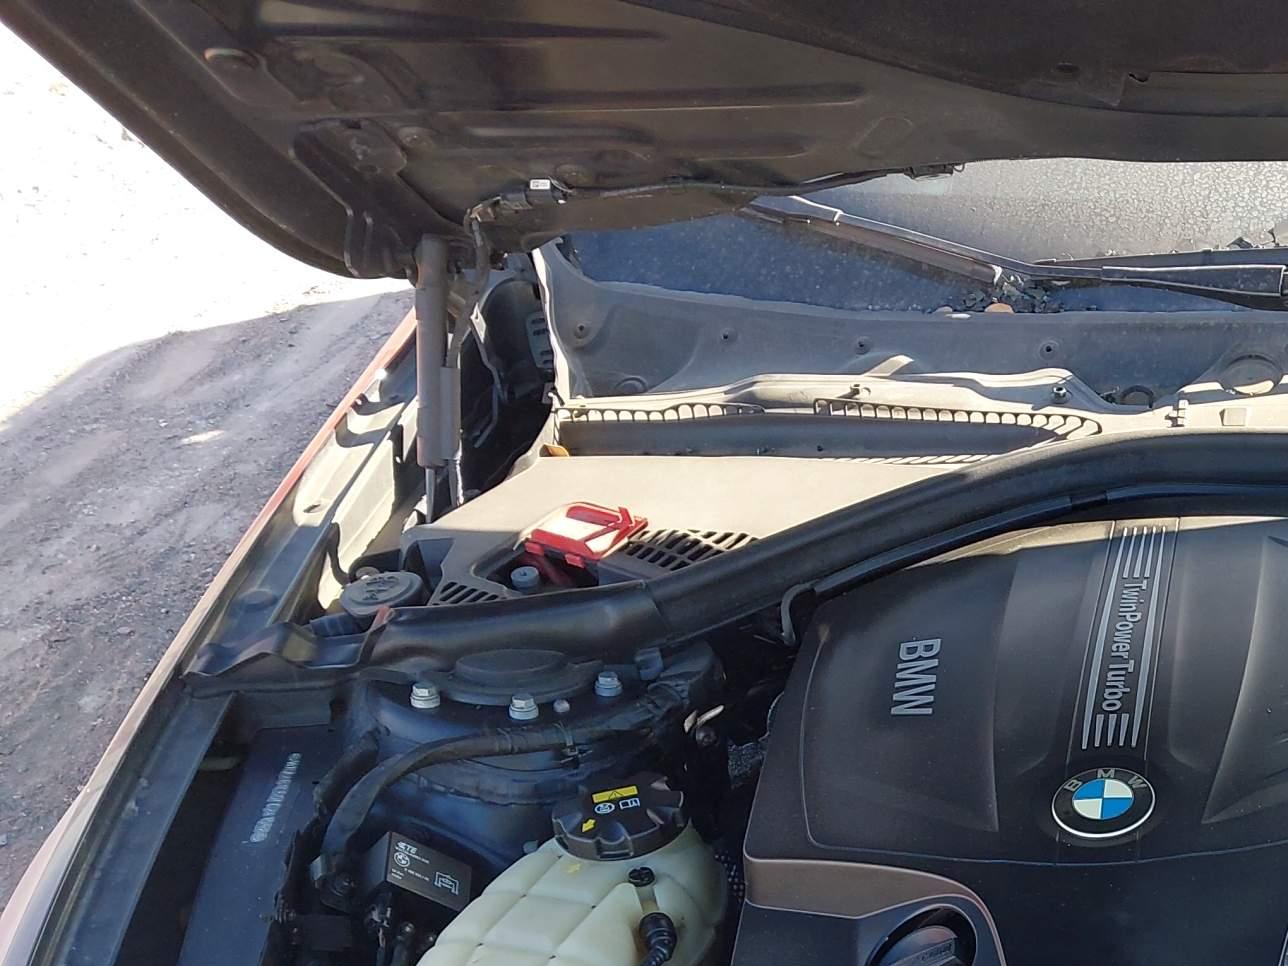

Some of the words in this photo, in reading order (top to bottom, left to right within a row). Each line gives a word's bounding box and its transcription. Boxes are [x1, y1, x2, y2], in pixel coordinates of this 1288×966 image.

[1111, 580, 1147, 659] TwinPower
[891, 639, 941, 715] BMW
[1102, 660, 1134, 711] Turbo
[1063, 767, 1147, 791] BMW
